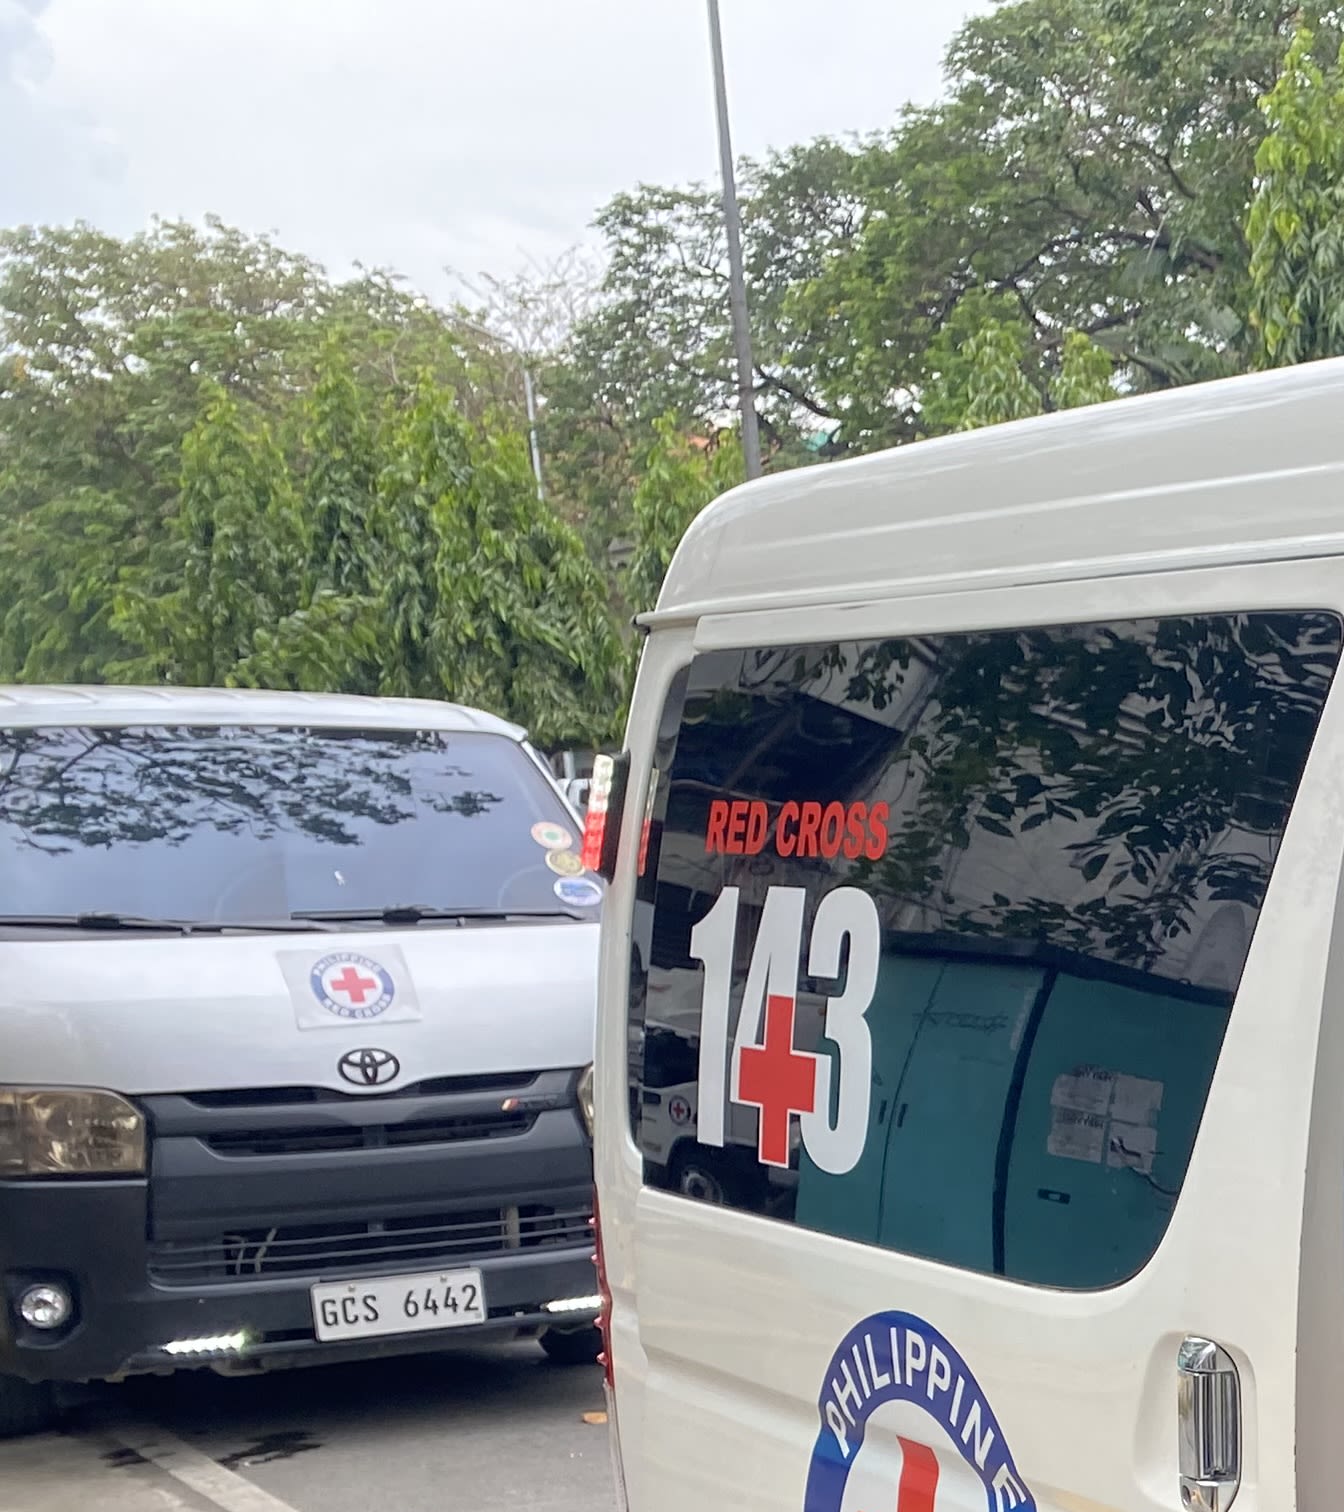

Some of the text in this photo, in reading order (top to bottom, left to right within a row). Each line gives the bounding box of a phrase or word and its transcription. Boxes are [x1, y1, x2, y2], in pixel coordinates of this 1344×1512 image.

[706, 800, 890, 861] RED CROSS
[689, 886, 881, 1175] 143
[321, 1284, 479, 1327] GCS 6442
